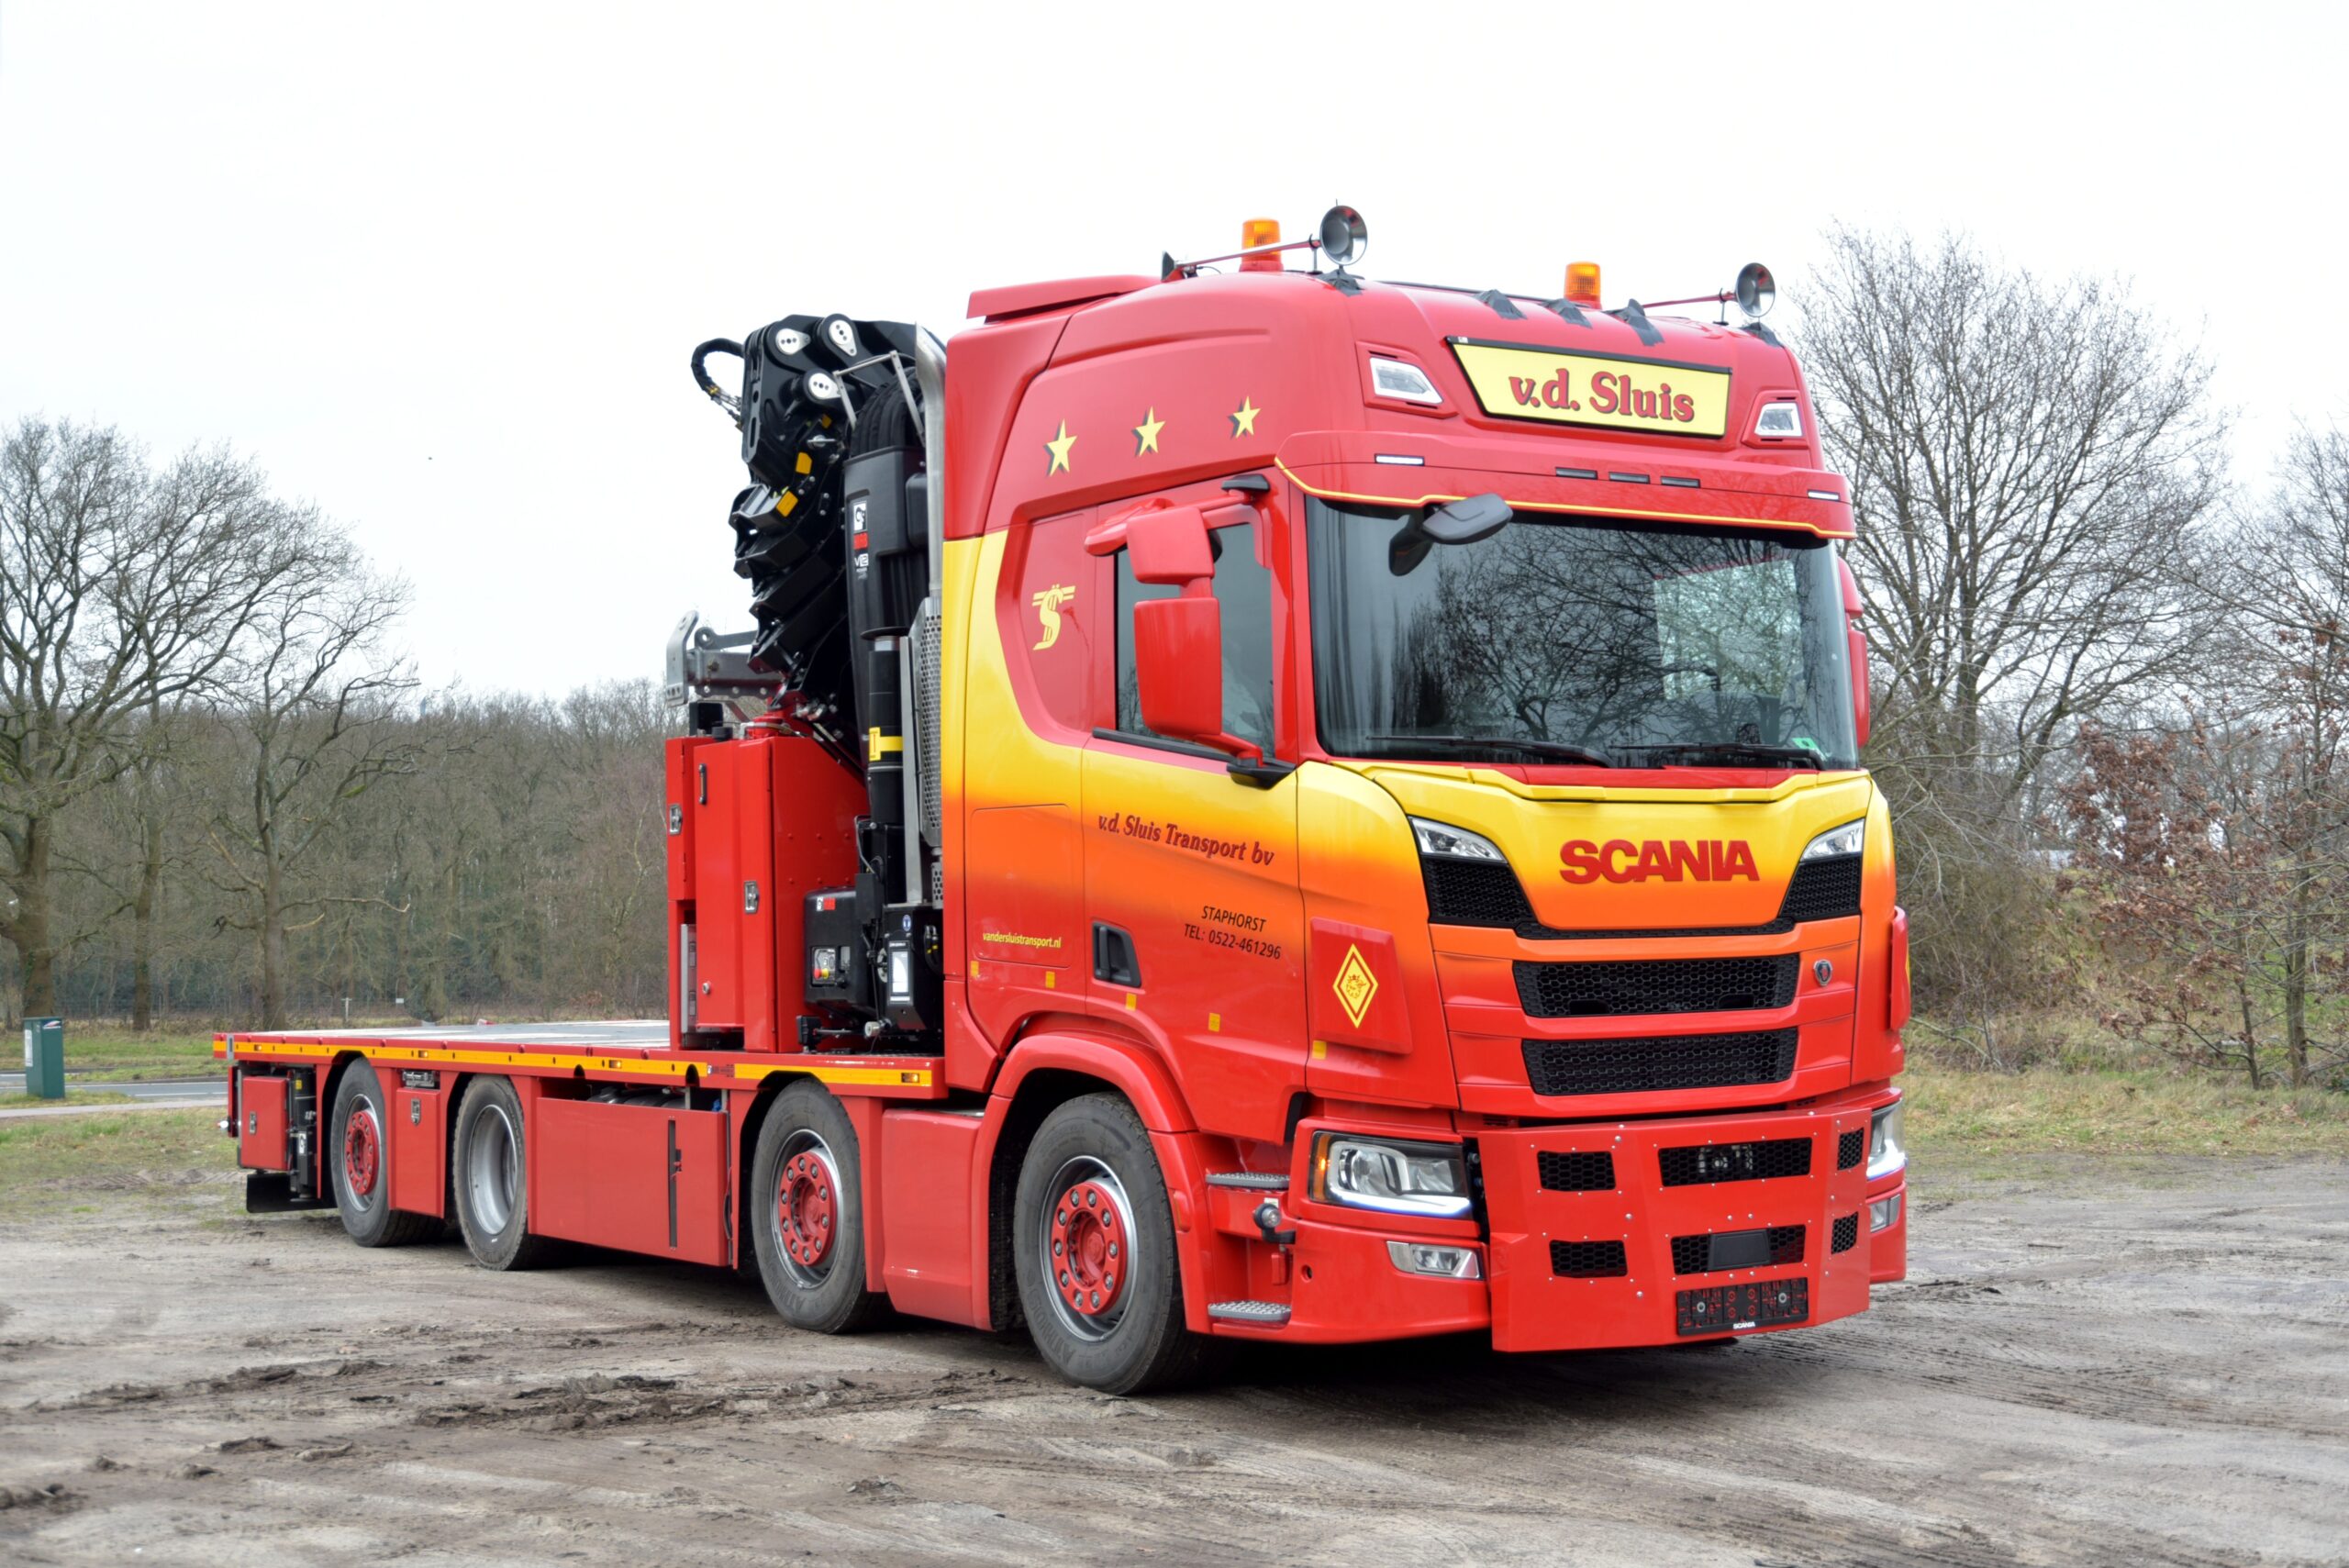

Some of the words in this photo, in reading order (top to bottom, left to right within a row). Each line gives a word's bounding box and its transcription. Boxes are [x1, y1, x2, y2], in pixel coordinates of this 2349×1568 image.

[1508, 368, 1581, 411] v.d.
[1589, 371, 1696, 423] Sluis
[1098, 813, 1119, 834] v.d.
[1123, 815, 1162, 842] Sluis
[1165, 823, 1247, 861] Transport
[1252, 841, 1275, 866] bv
[1560, 839, 1760, 884] SCANIA
[1201, 905, 1267, 933] STAPHORST
[983, 931, 1062, 949] vandersluistransport.nl
[1184, 923, 1206, 941] TEL:
[1208, 929, 1282, 961] 0522-461296
